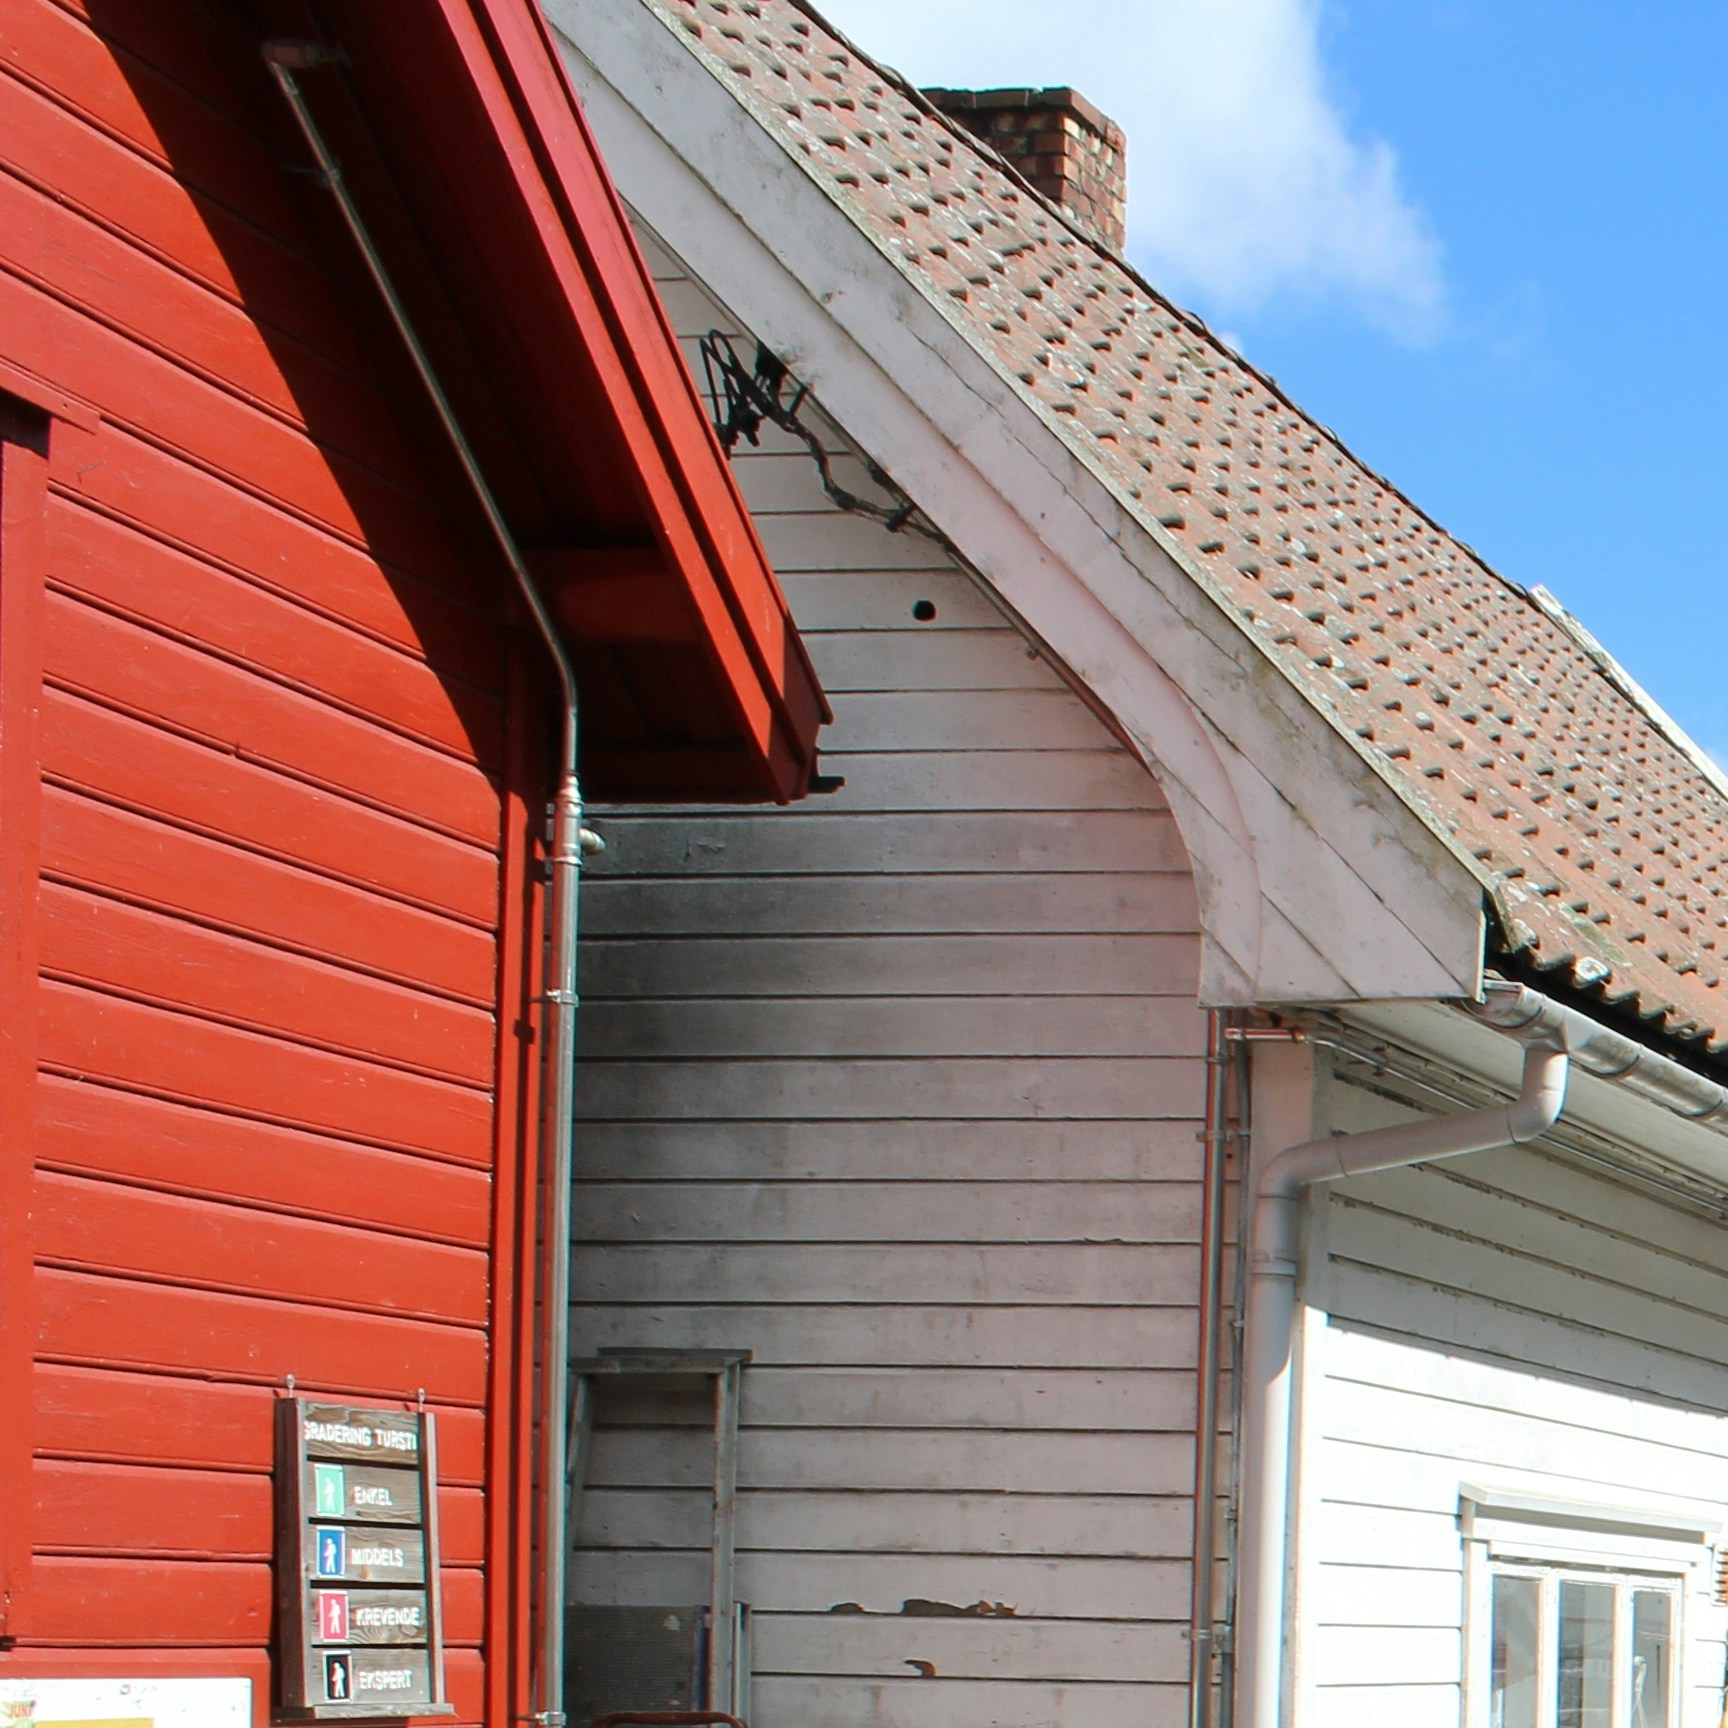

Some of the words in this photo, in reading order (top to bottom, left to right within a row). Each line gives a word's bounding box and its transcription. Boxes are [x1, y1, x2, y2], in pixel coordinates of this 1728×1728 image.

[374, 1429, 417, 1450] TURSTI
[354, 1486, 393, 1506] ENKEL
[351, 1548, 404, 1567] MIDDELS
[355, 1607, 420, 1626] KREVENDE
[359, 1670, 412, 1690] EKSPERT
